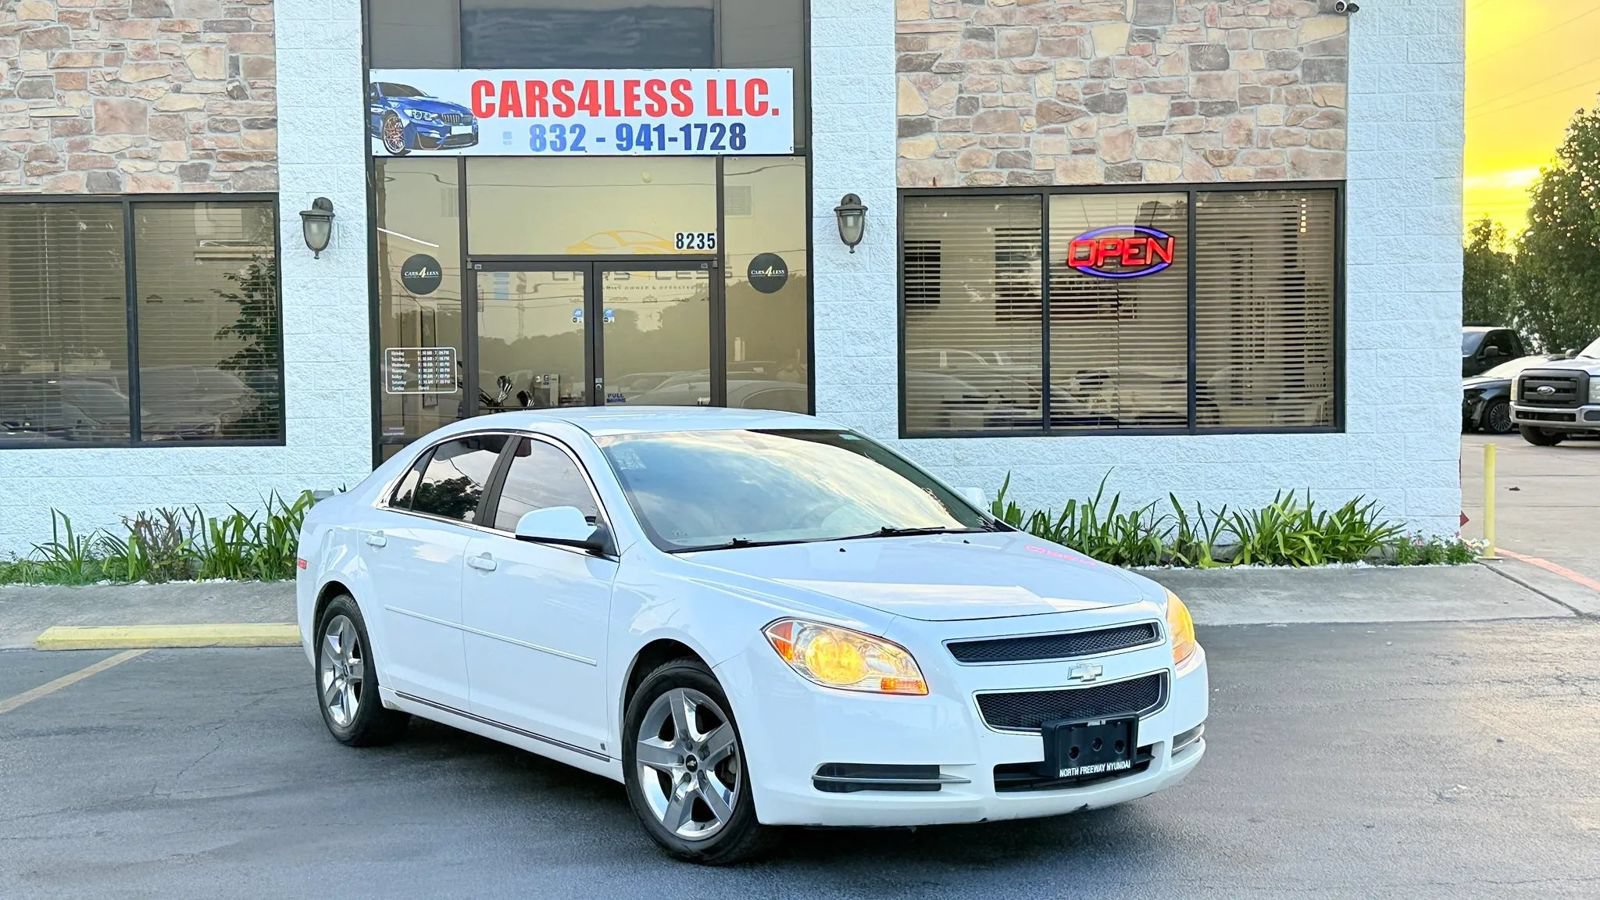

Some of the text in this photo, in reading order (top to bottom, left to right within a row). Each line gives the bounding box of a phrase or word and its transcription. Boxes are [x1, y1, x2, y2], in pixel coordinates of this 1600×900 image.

[471, 78, 779, 118] CARS4LESS LLC.
[529, 123, 586, 152] 832
[615, 122, 747, 151] 941-1728
[676, 233, 715, 249] 8235
[1067, 236, 1175, 267] OPEN
[1059, 760, 1131, 778] NORTH FREEWAY HYUNDAI
